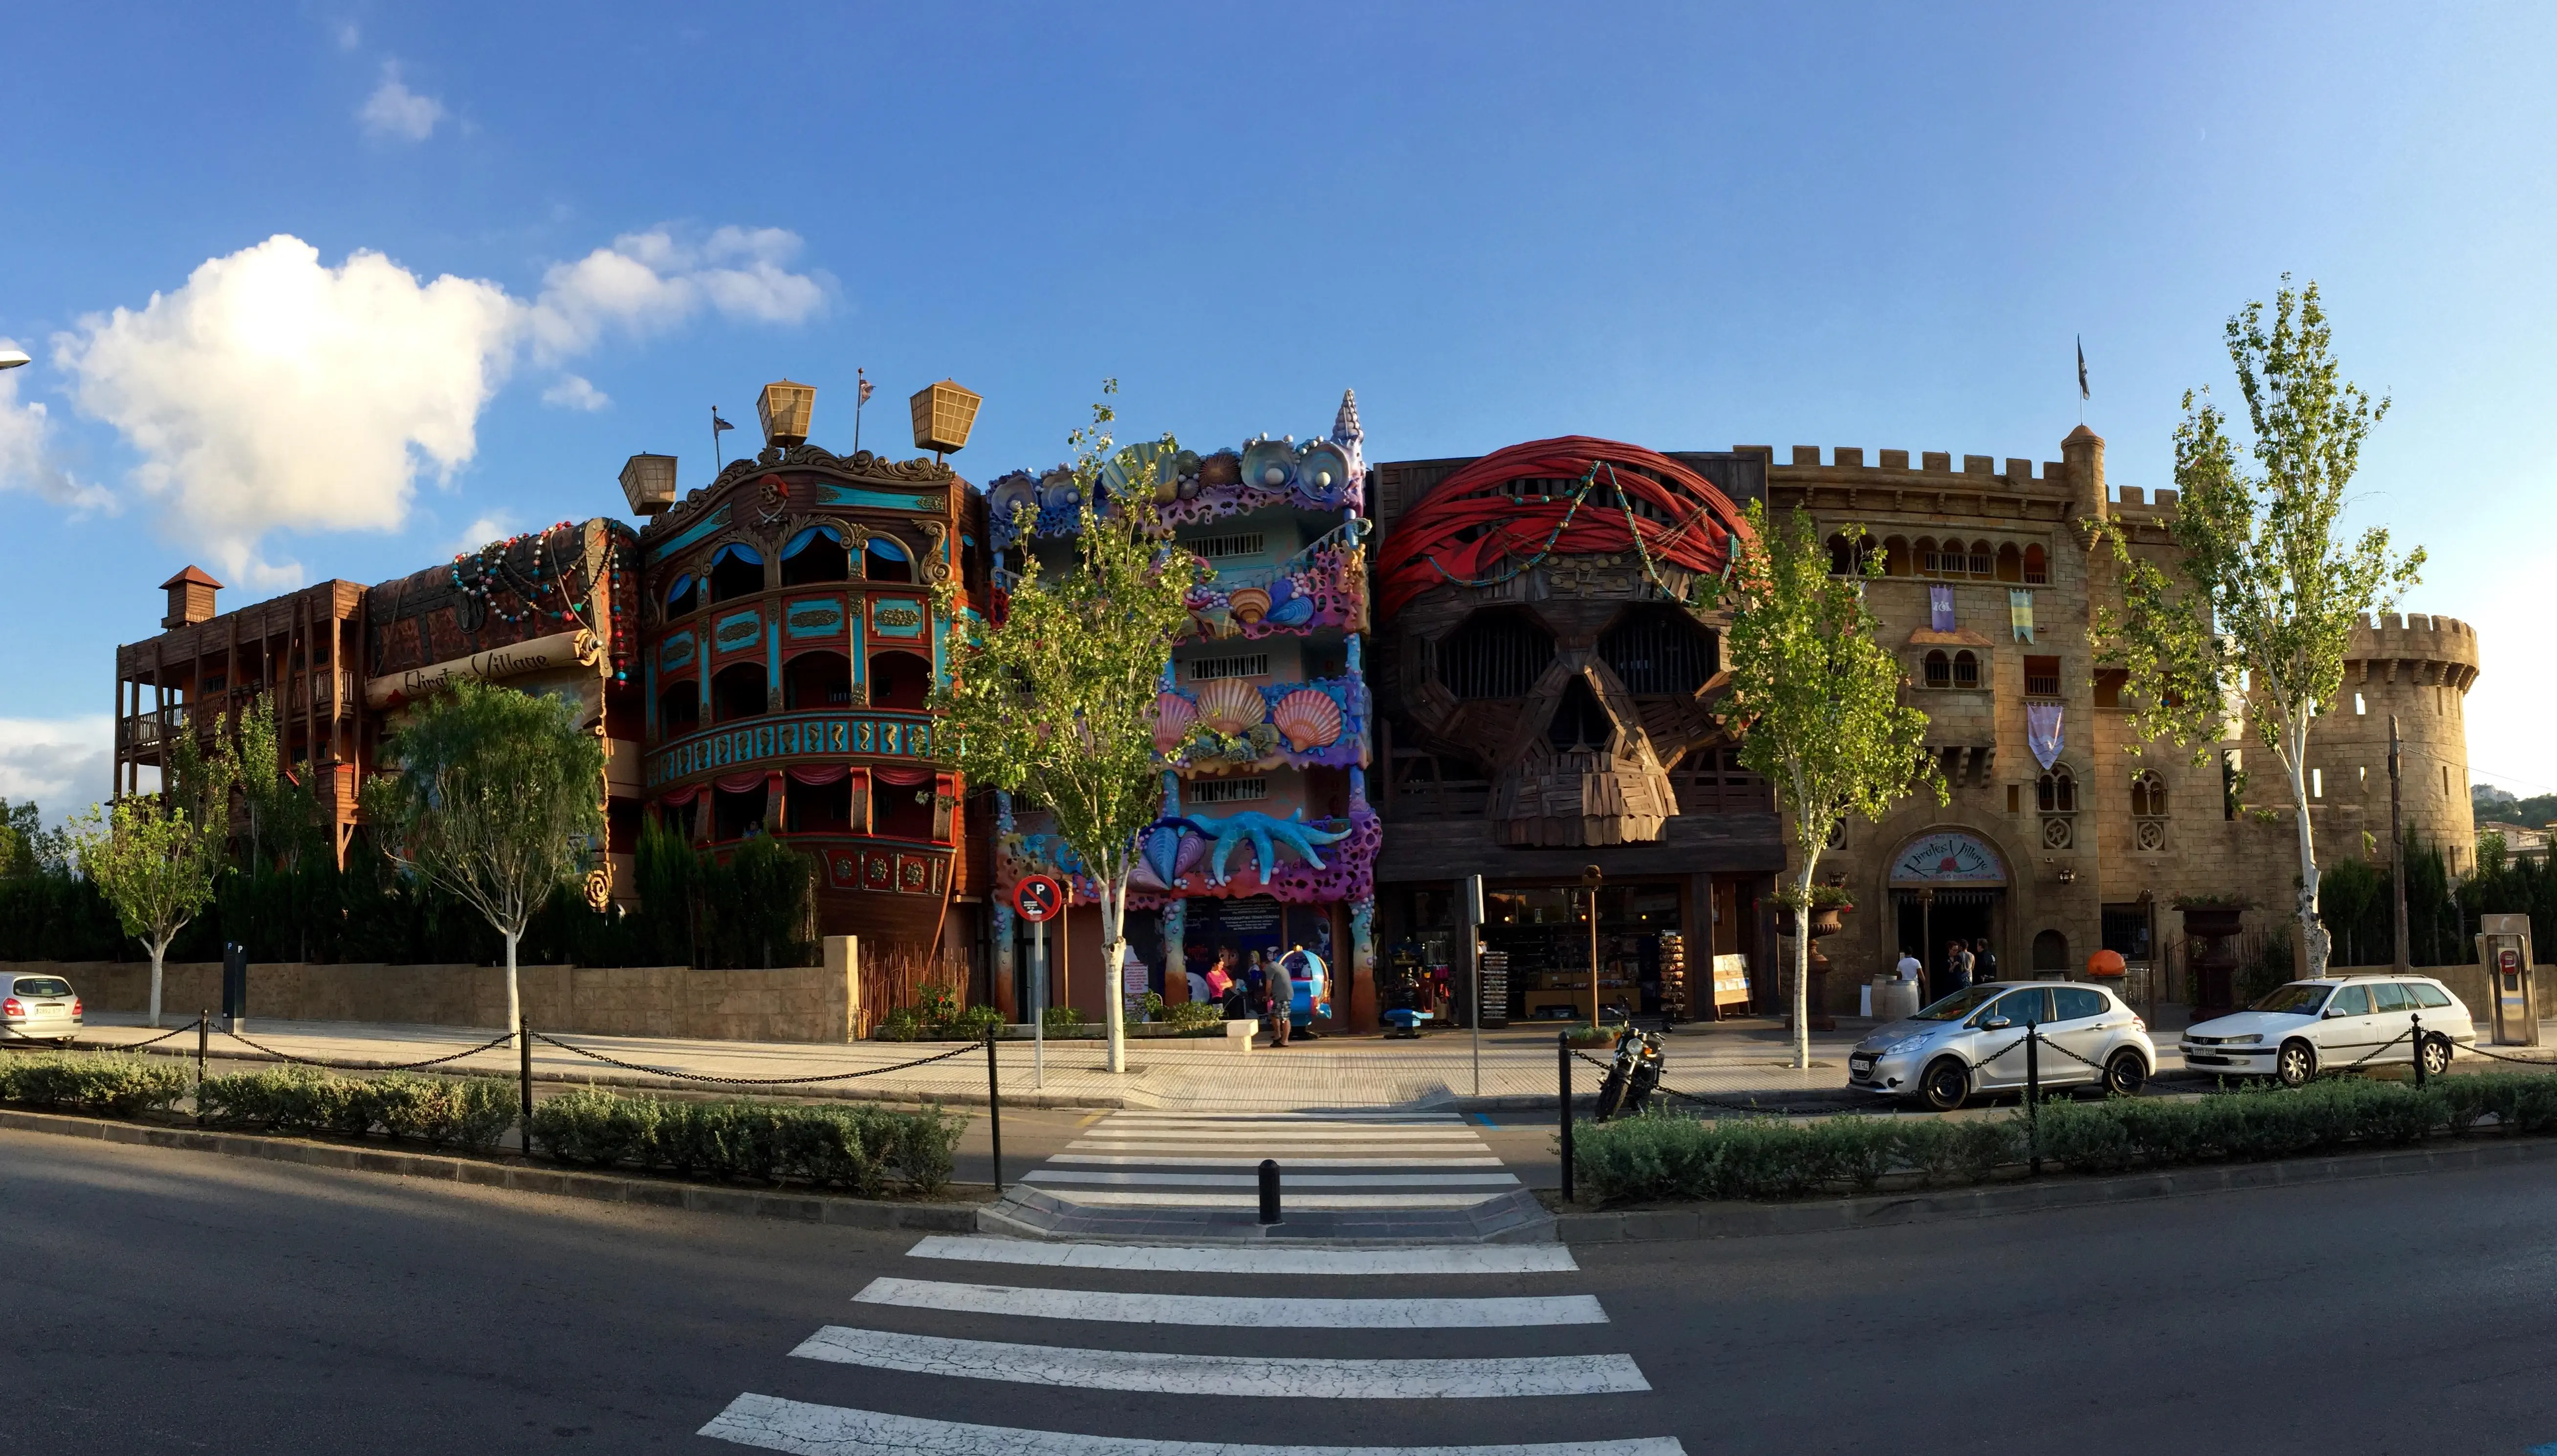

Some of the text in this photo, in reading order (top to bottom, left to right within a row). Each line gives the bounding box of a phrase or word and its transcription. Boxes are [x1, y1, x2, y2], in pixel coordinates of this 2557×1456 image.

[405, 652, 549, 695] Pirat Village
[1904, 840, 1988, 878] Pirates Village
[1036, 884, 1045, 894] P
